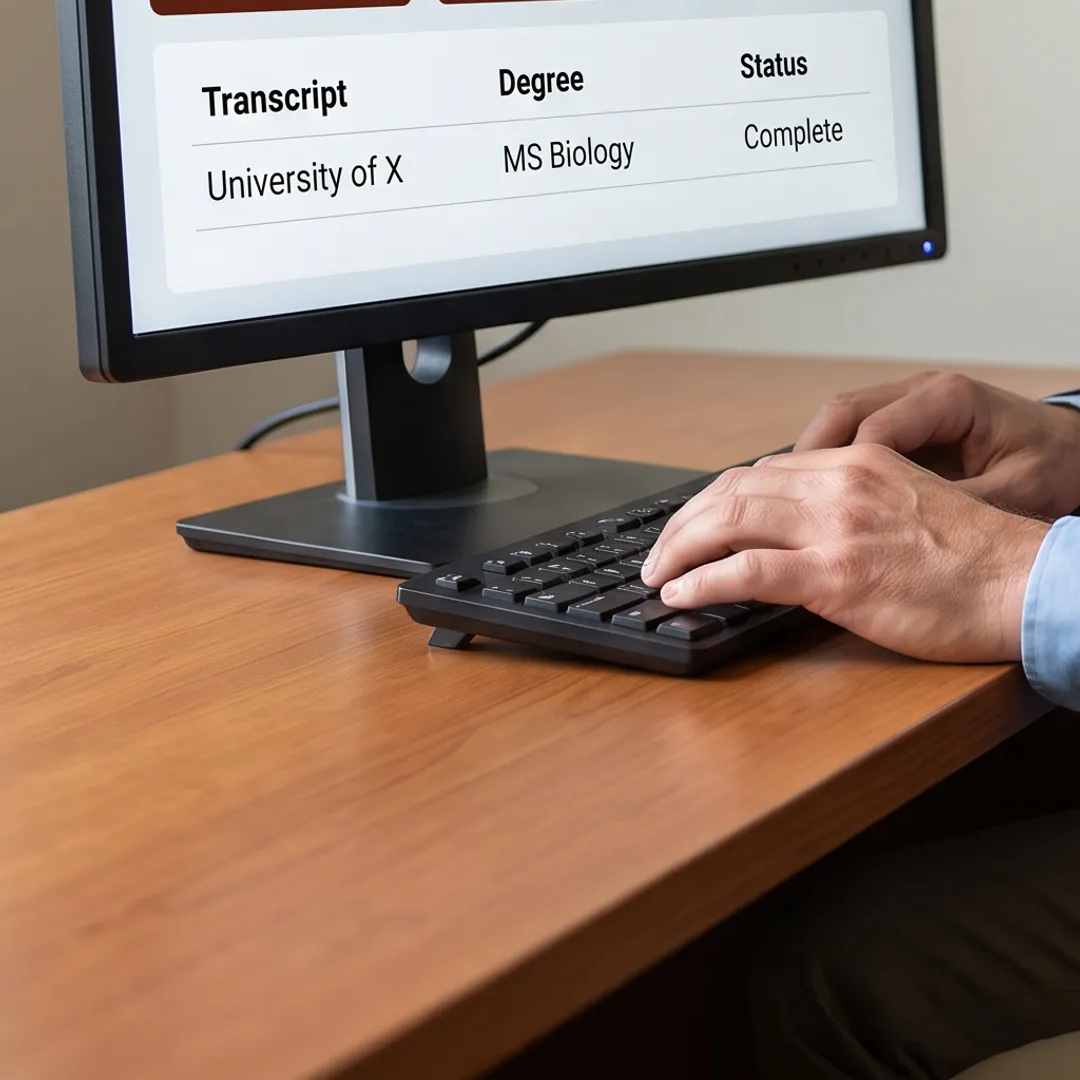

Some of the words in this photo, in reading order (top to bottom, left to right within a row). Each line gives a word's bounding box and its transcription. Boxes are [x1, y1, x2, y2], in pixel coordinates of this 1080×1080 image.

[740, 52, 808, 79] Status
[201, 79, 348, 117] Transcript
[498, 68, 584, 102] Degree
[744, 117, 843, 152] Complete
[503, 142, 543, 173] MS
[550, 136, 634, 170] Biology
[207, 163, 343, 201] University
[351, 155, 378, 188] of
[385, 154, 404, 185] X
